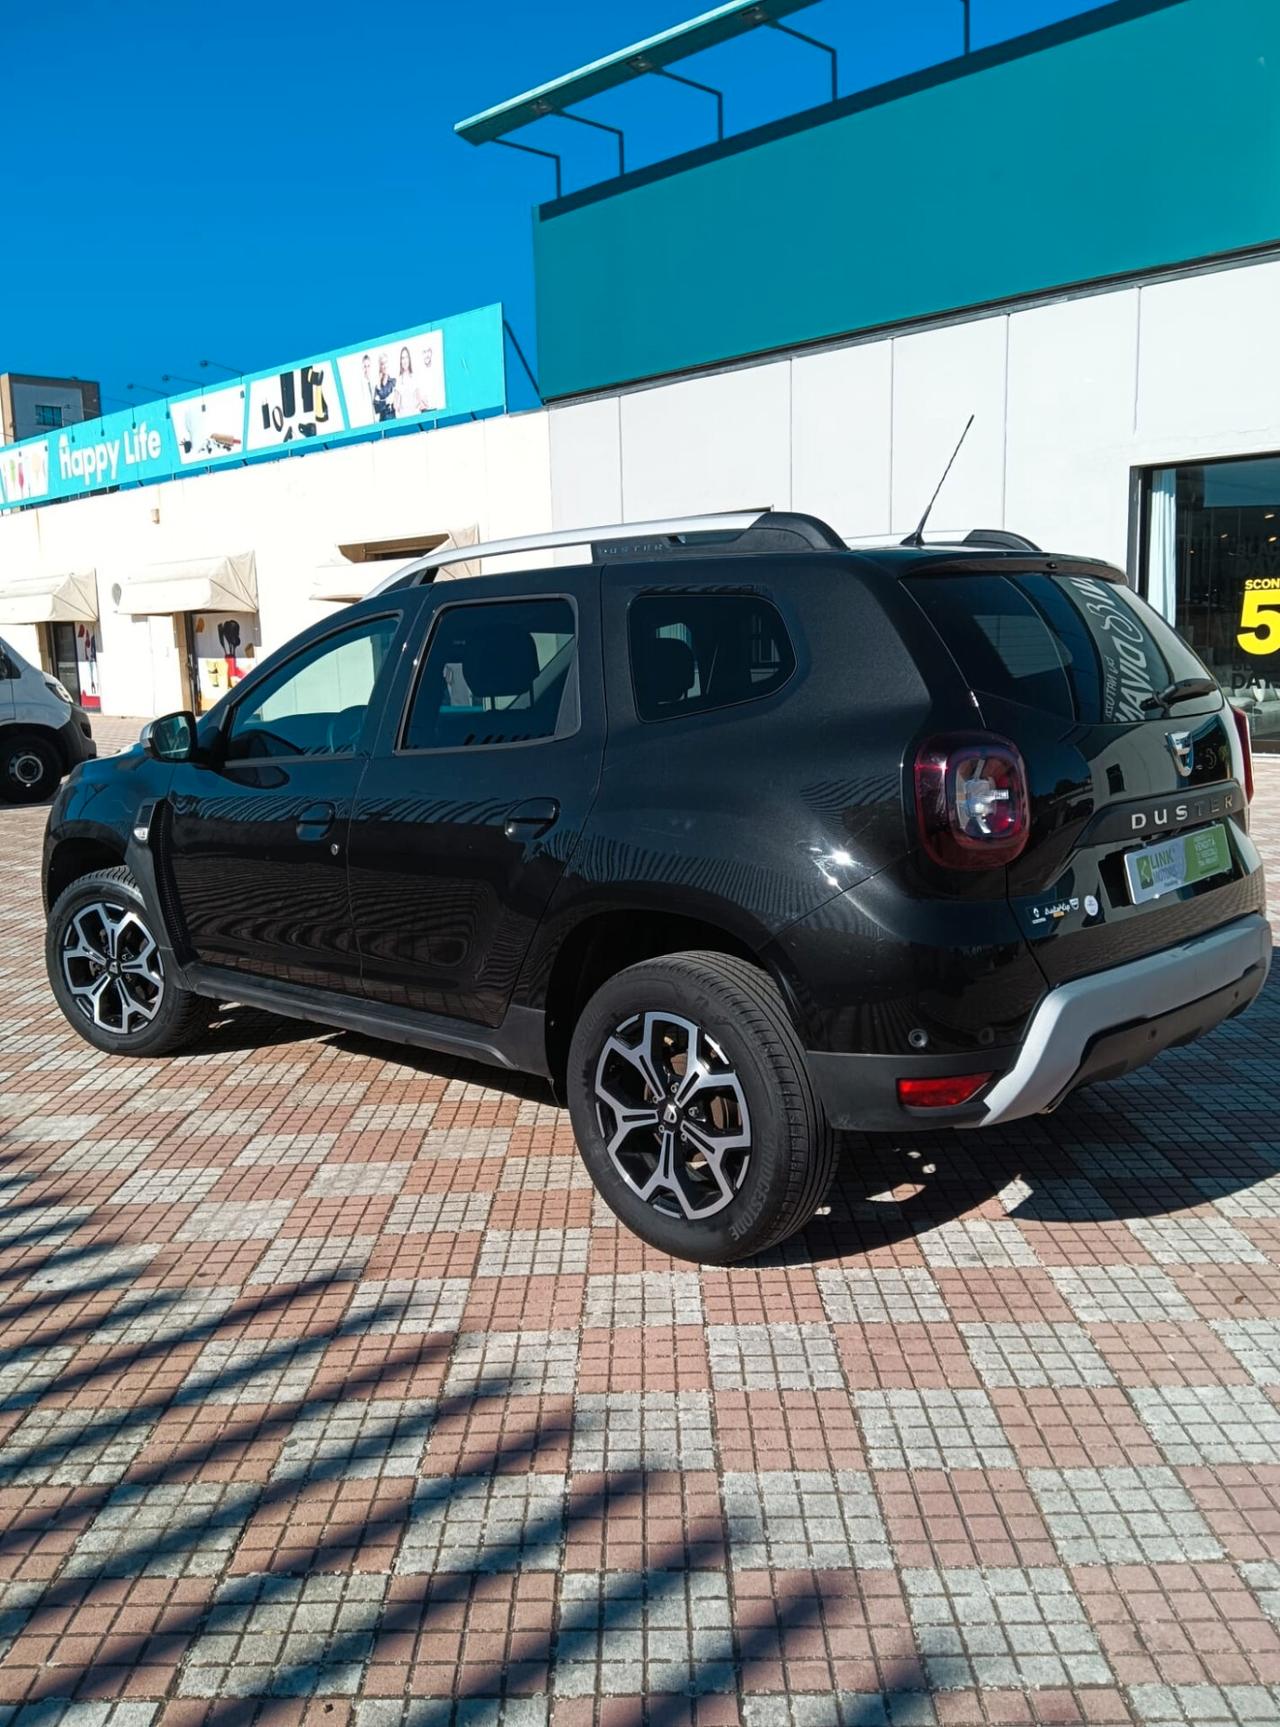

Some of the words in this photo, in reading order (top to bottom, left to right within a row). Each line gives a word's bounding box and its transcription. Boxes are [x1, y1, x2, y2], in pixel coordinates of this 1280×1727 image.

[58, 434, 120, 486] Happy
[123, 421, 162, 465] Life
[1131, 795, 1233, 830] DUSTER
[1149, 848, 1173, 869] LINK
